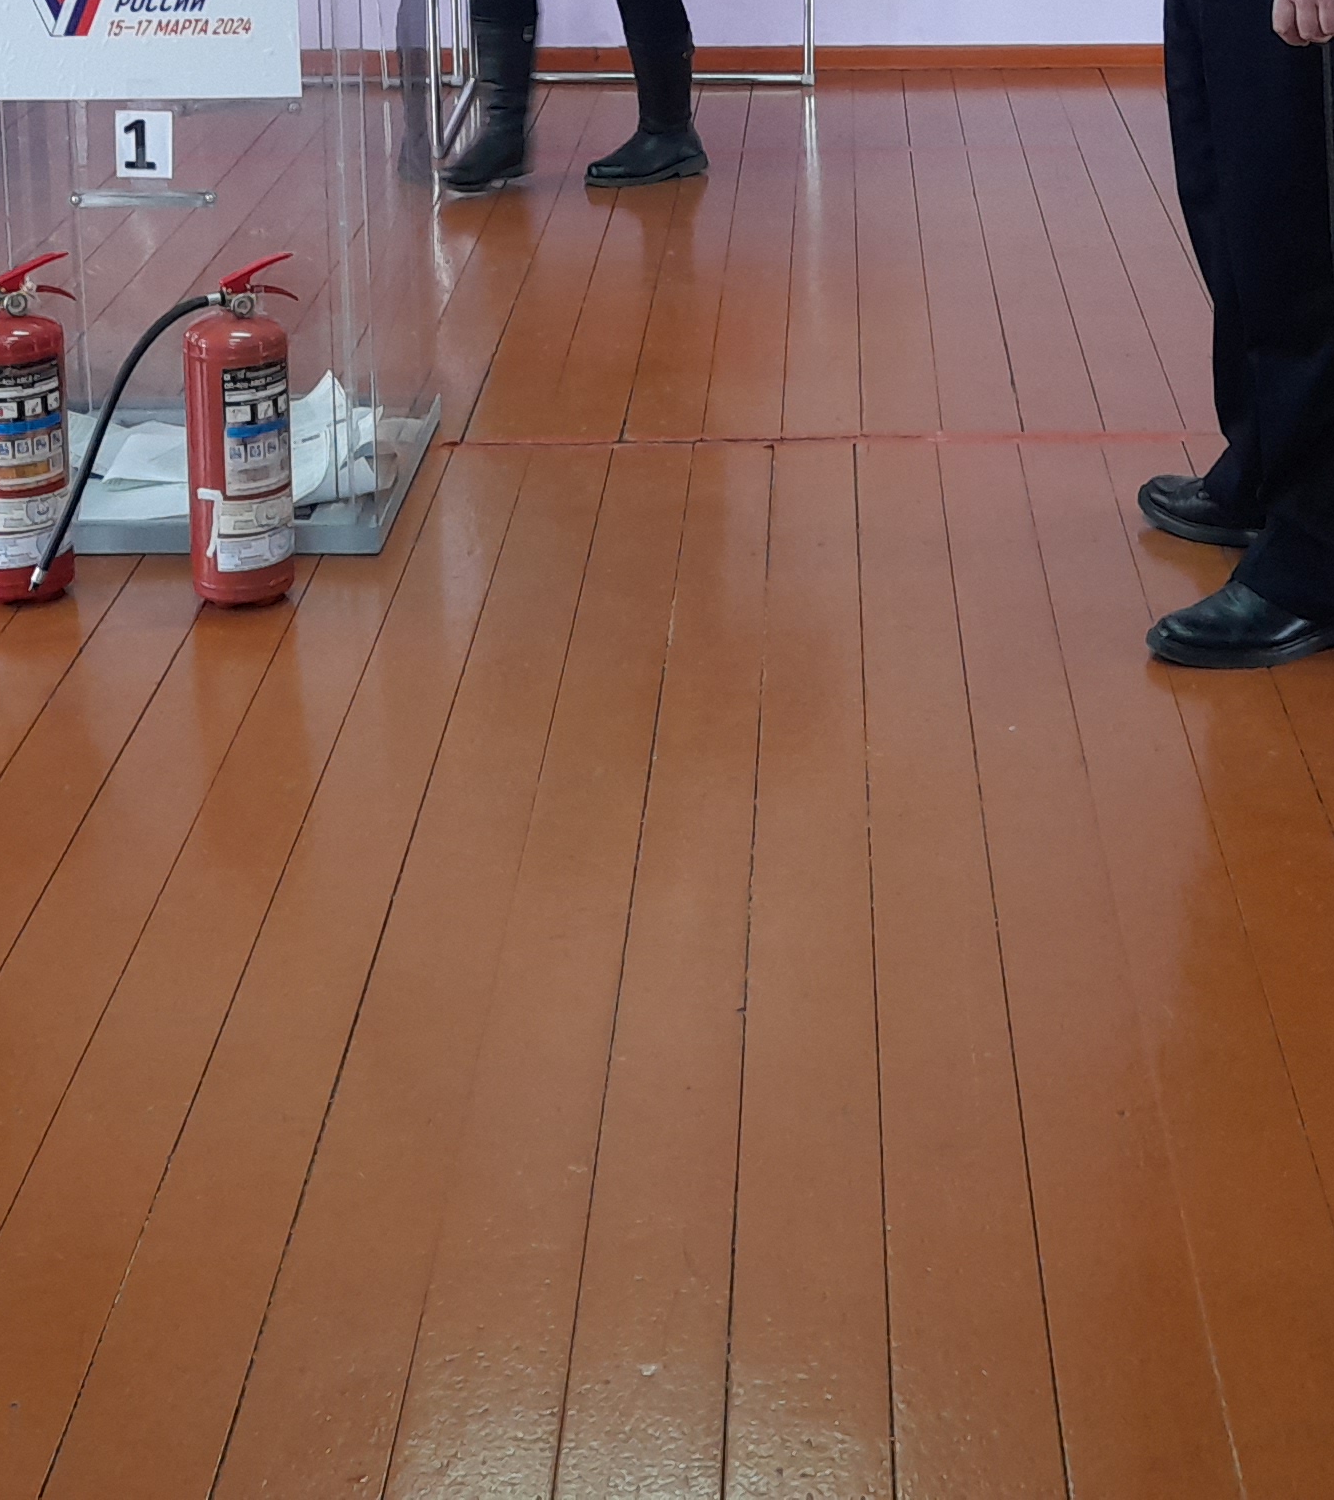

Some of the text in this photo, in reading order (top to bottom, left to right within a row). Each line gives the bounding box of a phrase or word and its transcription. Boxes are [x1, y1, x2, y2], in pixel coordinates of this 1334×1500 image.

[107, 17, 252, 37] 15–17 МАРТА 2024
[124, 119, 156, 170] 1
